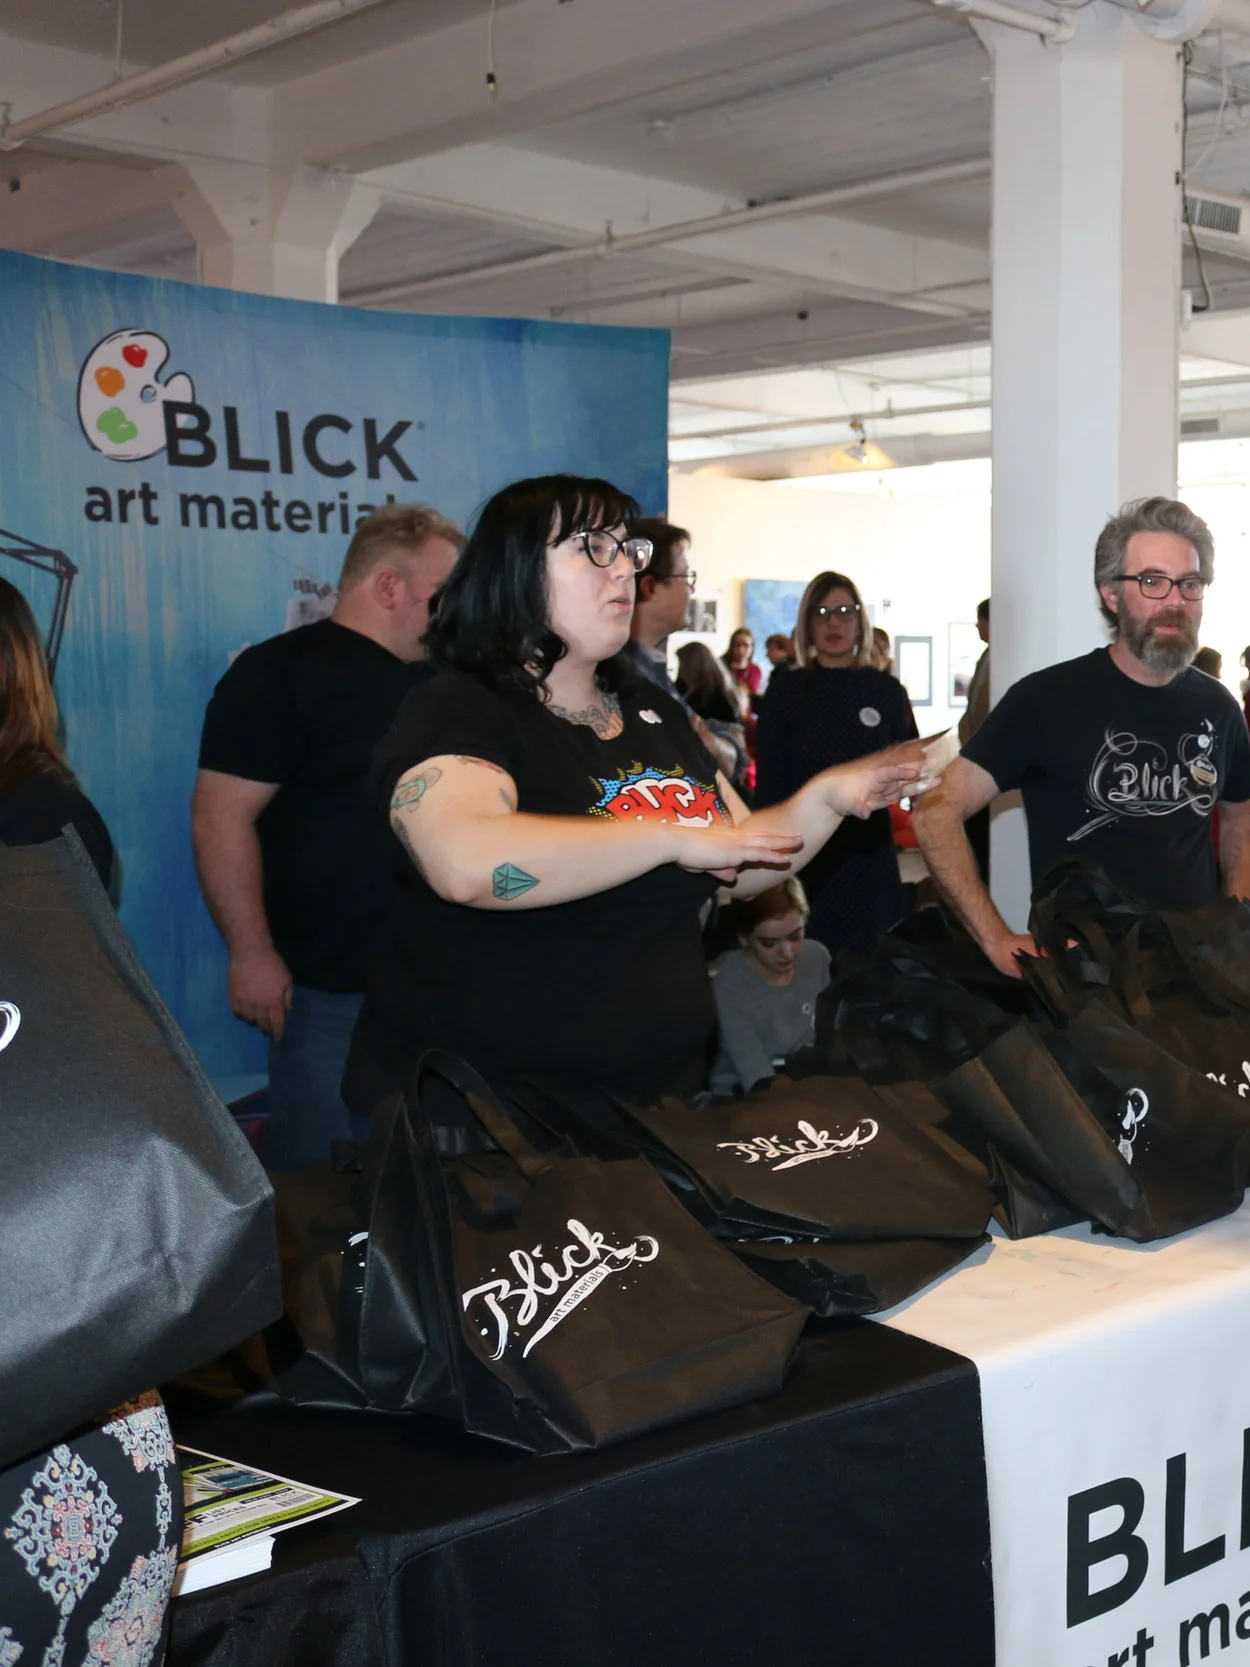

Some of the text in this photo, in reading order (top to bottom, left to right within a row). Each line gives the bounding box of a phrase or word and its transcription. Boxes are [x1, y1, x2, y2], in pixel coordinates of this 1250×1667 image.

[162, 400, 419, 482] BLICK
[84, 482, 396, 535] art materia
[1107, 760, 1188, 802] Blick
[717, 1120, 841, 1164] Blick
[462, 1218, 613, 1360] Blick
[550, 1269, 605, 1323] art materials
